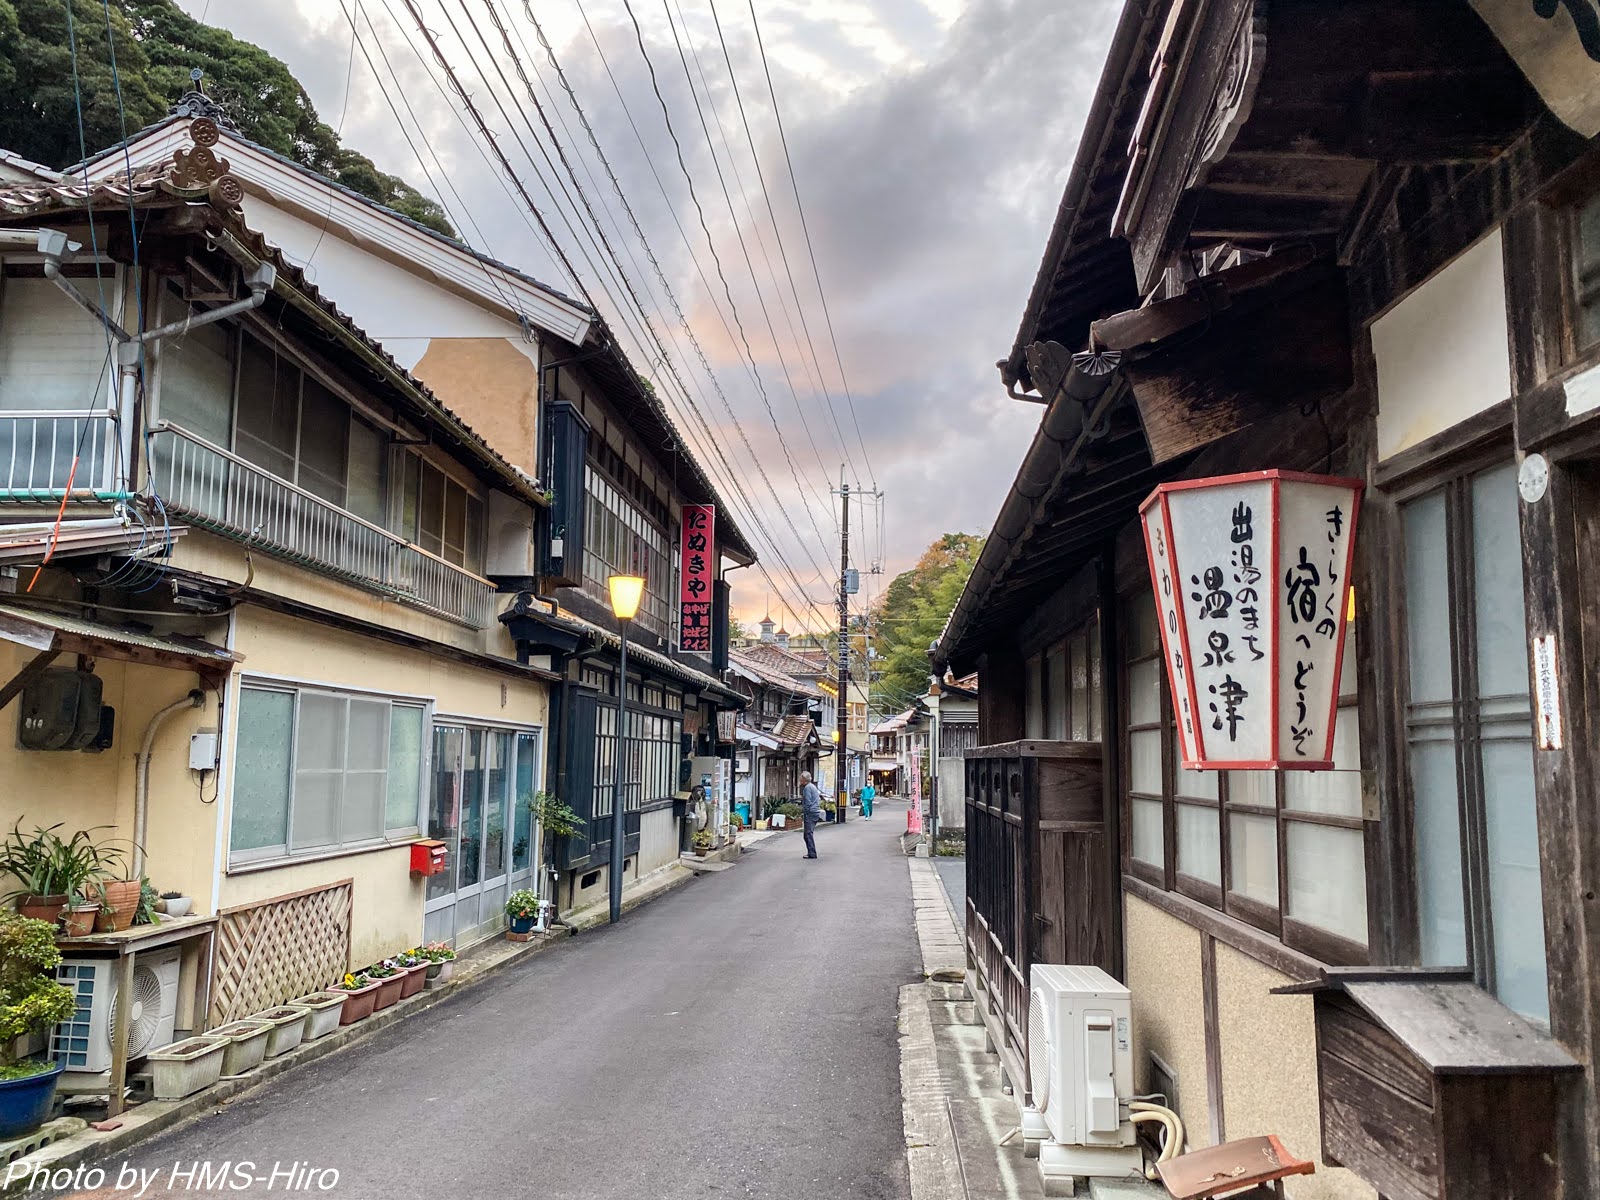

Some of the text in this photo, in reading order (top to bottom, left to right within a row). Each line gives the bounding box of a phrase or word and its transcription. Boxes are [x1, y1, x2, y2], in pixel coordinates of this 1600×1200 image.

[687, 509, 707, 598] たぬきや
[1230, 500, 1265, 662] 出湯のまち
[682, 626, 709, 638] たばこ
[682, 638, 709, 651] アイス
[1190, 565, 1249, 742] 温泉津
[1284, 547, 1321, 757] 宿へどうぞ
